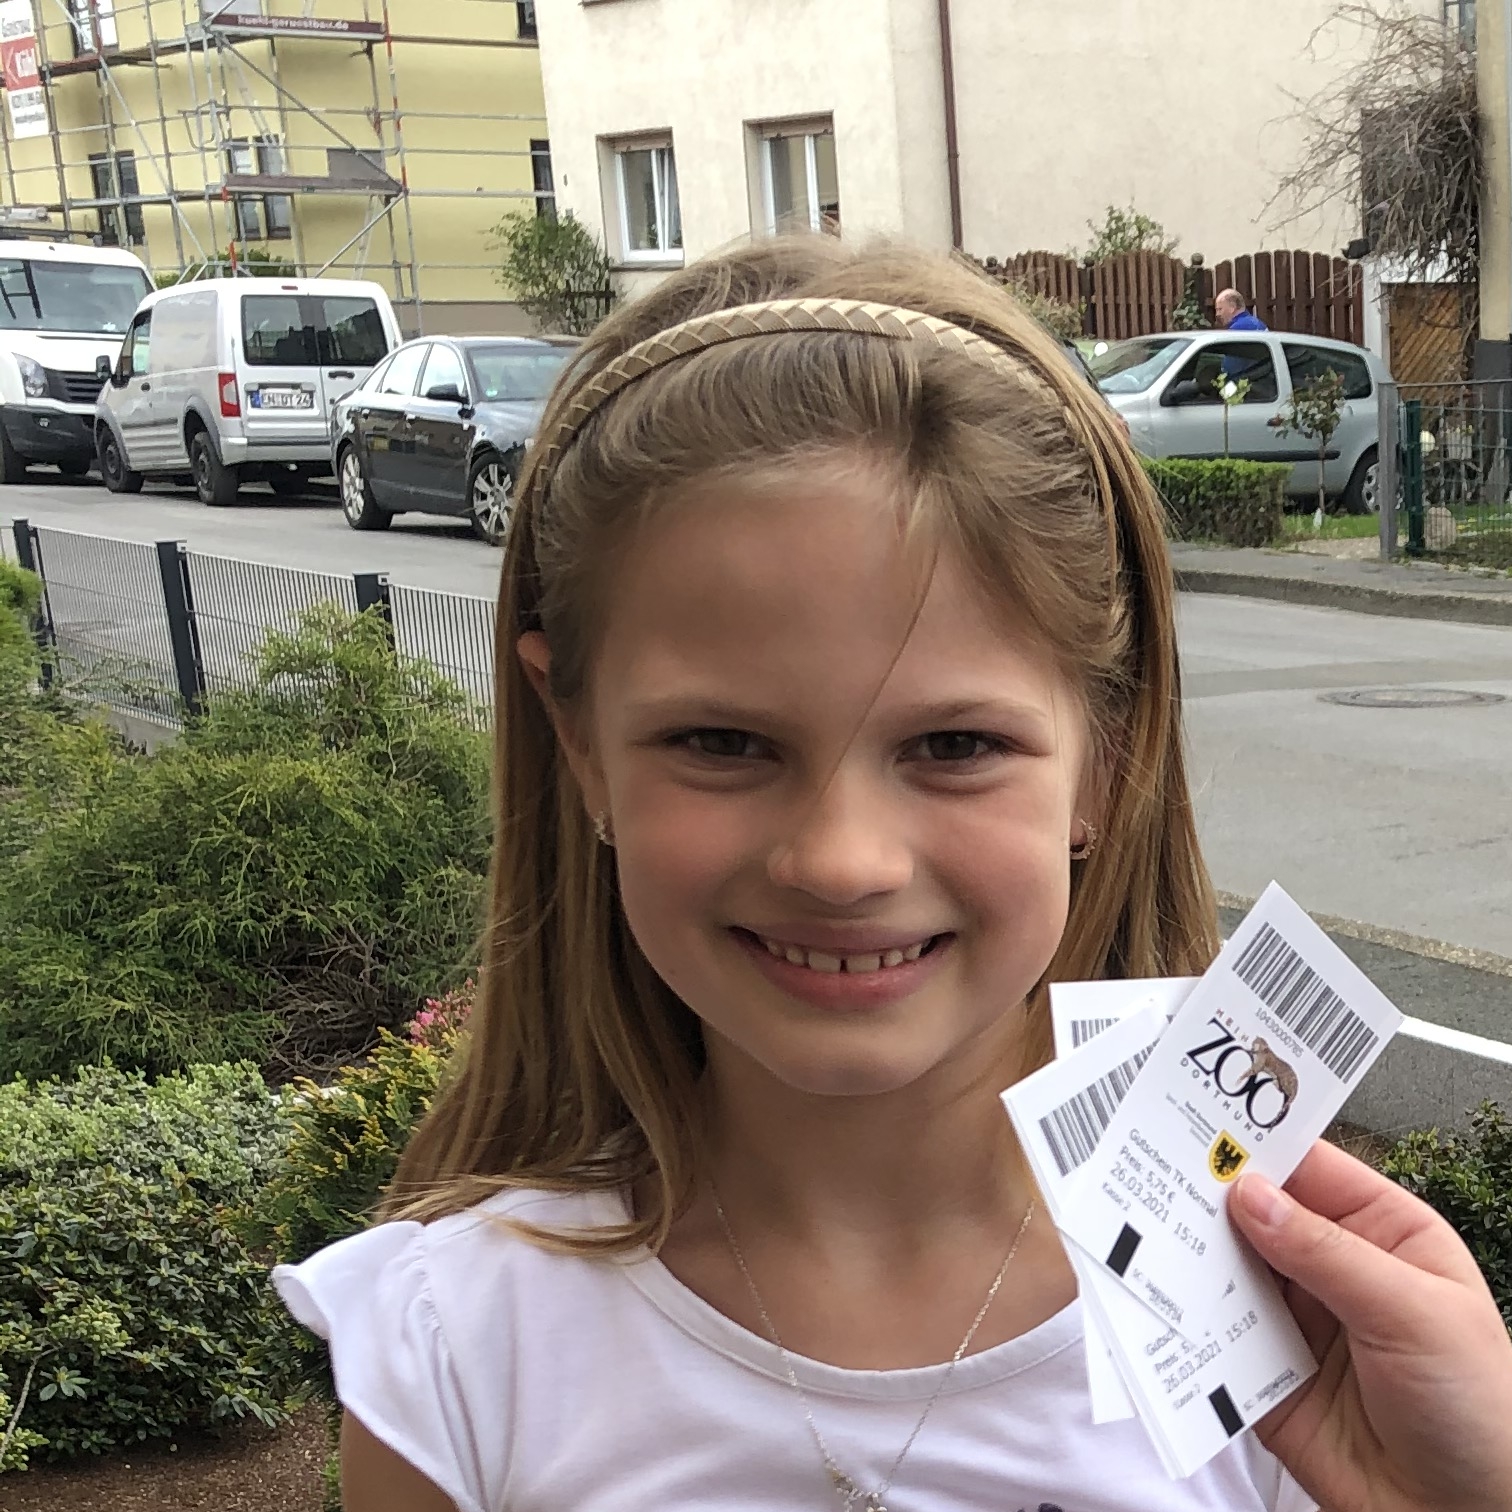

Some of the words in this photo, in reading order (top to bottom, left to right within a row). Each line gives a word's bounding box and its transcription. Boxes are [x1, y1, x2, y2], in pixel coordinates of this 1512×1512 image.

[1179, 1056, 1265, 1143] DORTMUND
[1185, 1017, 1292, 1131] ZOO
[1109, 1160, 1171, 1225] 26.03.2021
[1173, 1221, 1208, 1257] 15:18
[1128, 1127, 1173, 1175] Gutschein
[1171, 1167, 1188, 1188] TK
[1185, 1182, 1219, 1219] Normal
[1145, 1169, 1169, 1196] 5,75
[1166, 1190, 1177, 1205] €
[1225, 1309, 1259, 1344] 15:18
